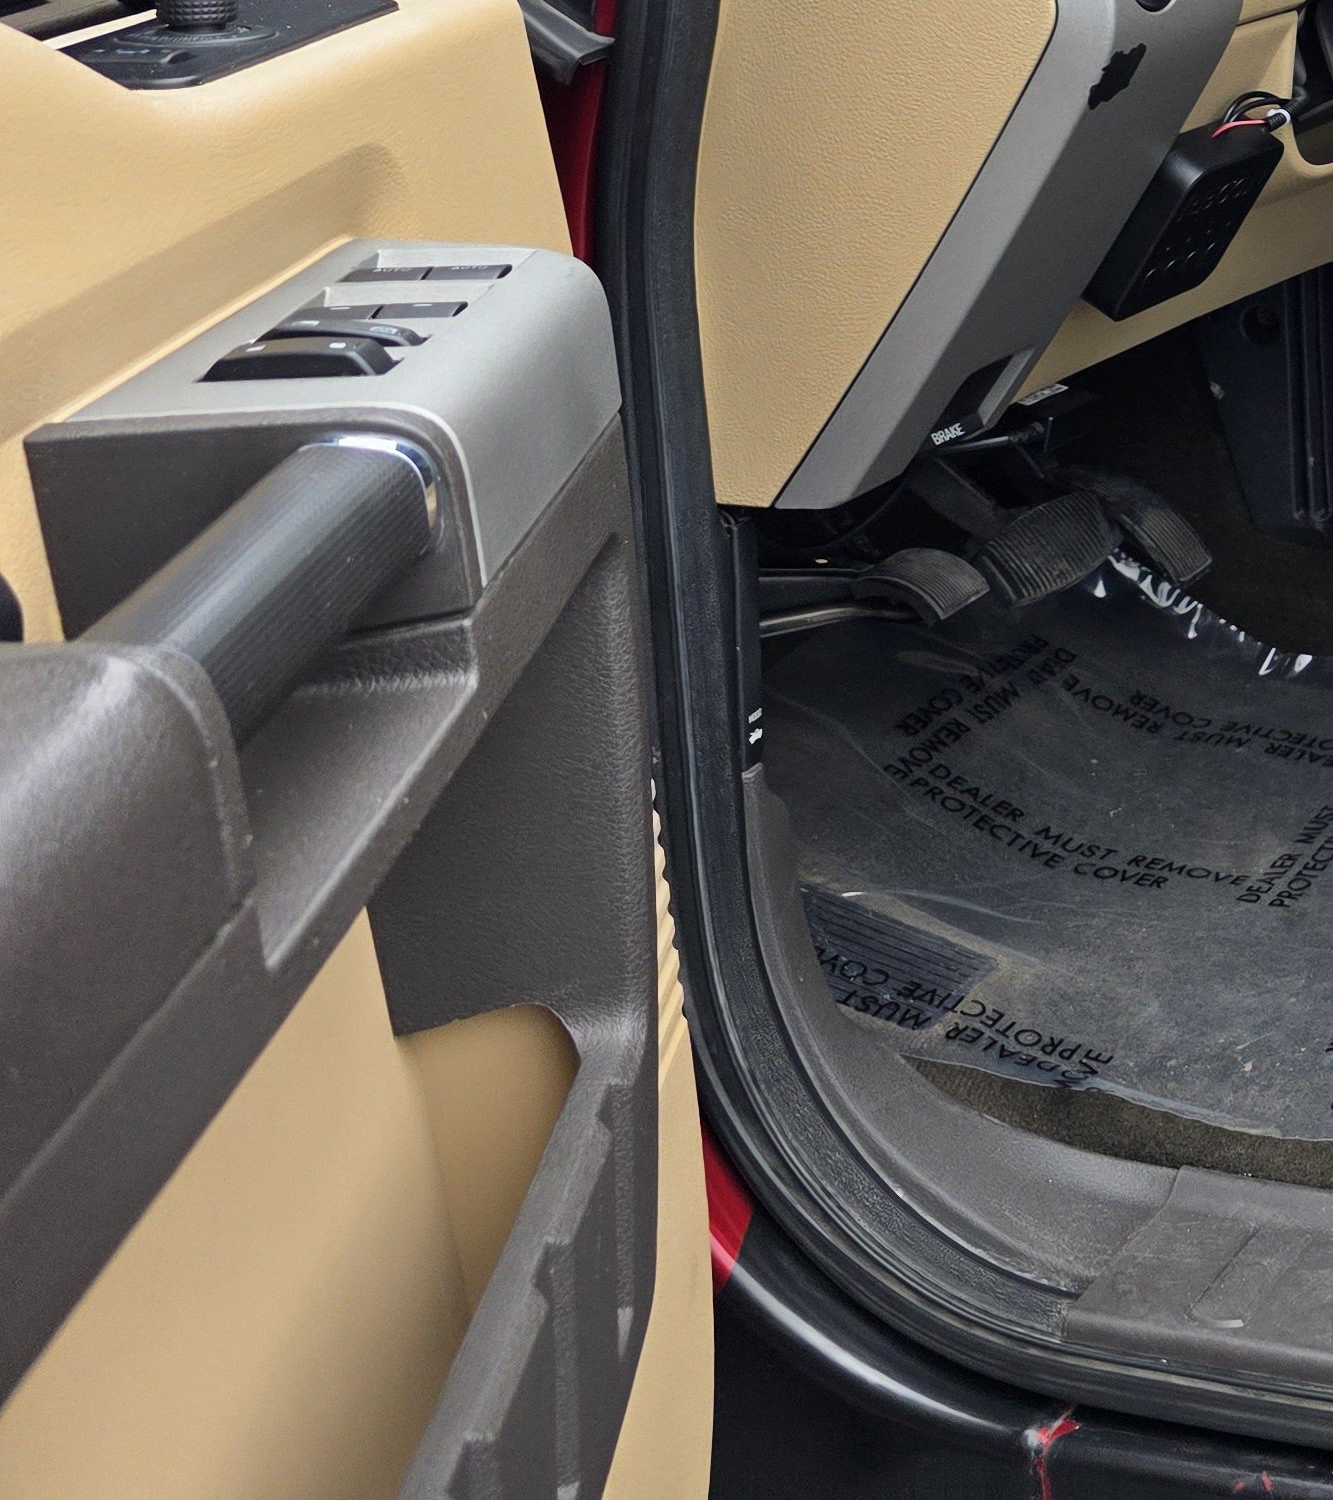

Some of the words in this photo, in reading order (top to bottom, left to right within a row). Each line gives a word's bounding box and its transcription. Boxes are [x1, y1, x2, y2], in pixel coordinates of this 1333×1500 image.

[897, 687, 964, 737] COVER
[967, 680, 1021, 725] MUST
[1062, 673, 1161, 736] REMOVE
[1130, 689, 1213, 729] COVER
[884, 718, 972, 782] REMOVE
[1174, 728, 1250, 748] MUST
[908, 774, 1067, 871] PROTECTIVE
[1073, 861, 1171, 890] COVER
[927, 762, 1026, 823] DEALER
[1033, 825, 1119, 861] MUST
[1127, 854, 1254, 887] REMOVE
[1236, 853, 1301, 904] DEALER
[836, 990, 932, 1031] MUST
[898, 978, 1089, 1060] PROTECTIVE
[945, 1022, 1056, 1073] DEALER
